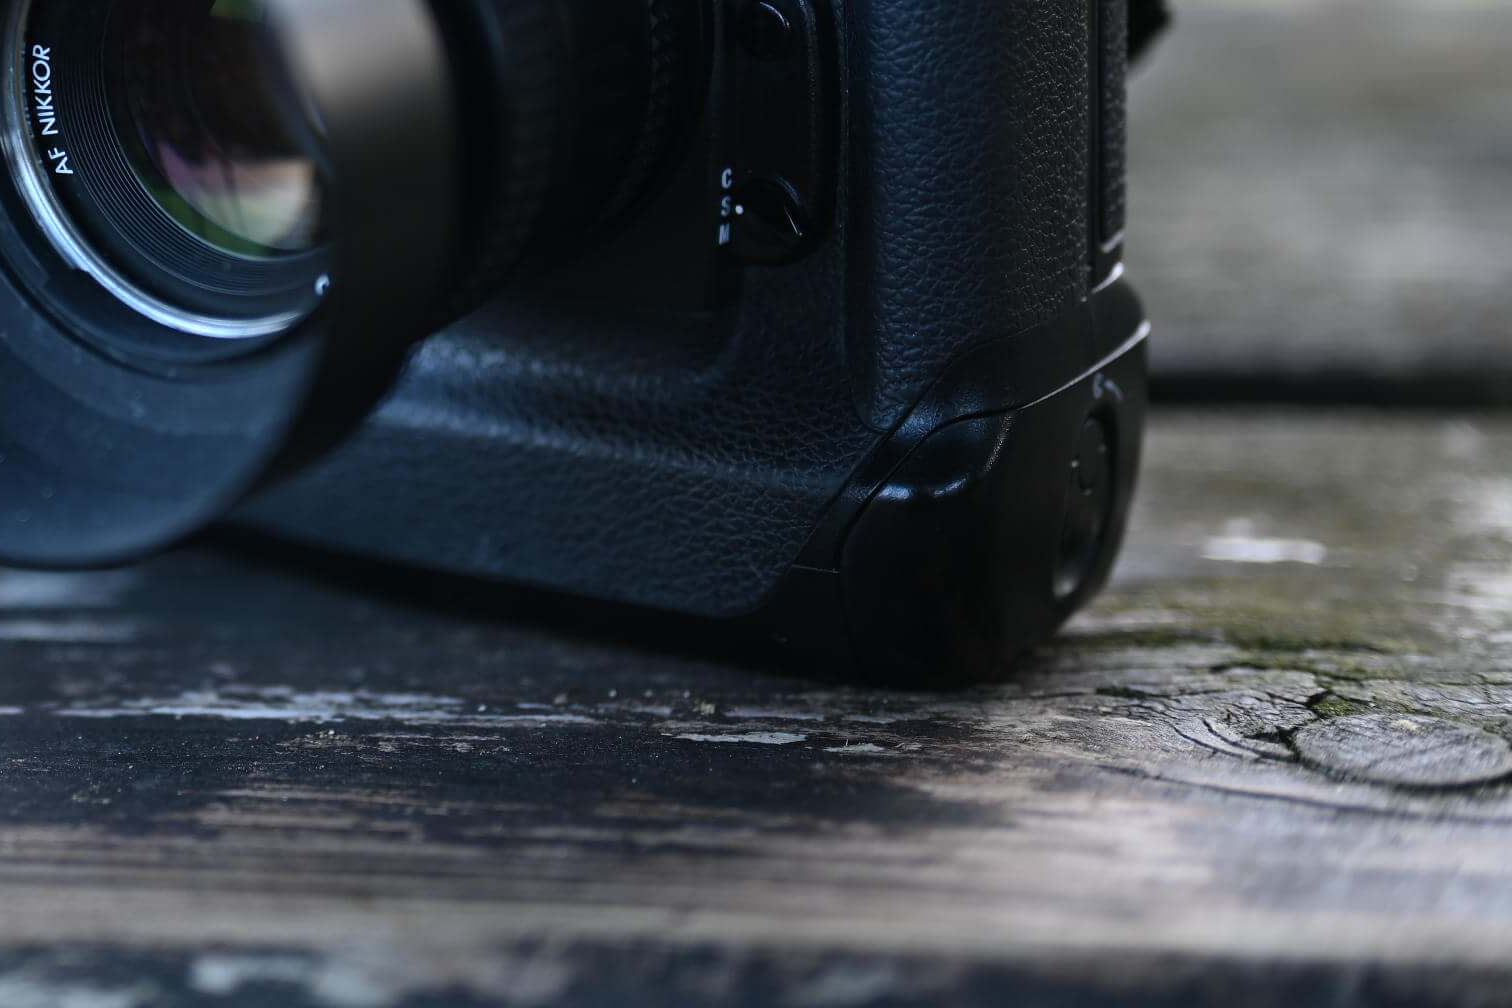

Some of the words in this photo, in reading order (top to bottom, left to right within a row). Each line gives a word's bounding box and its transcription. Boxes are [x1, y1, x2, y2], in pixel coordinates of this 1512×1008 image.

[31, 43, 60, 136] NIKKOR
[47, 146, 74, 175] AF
[721, 167, 732, 189] C
[720, 195, 731, 217] S
